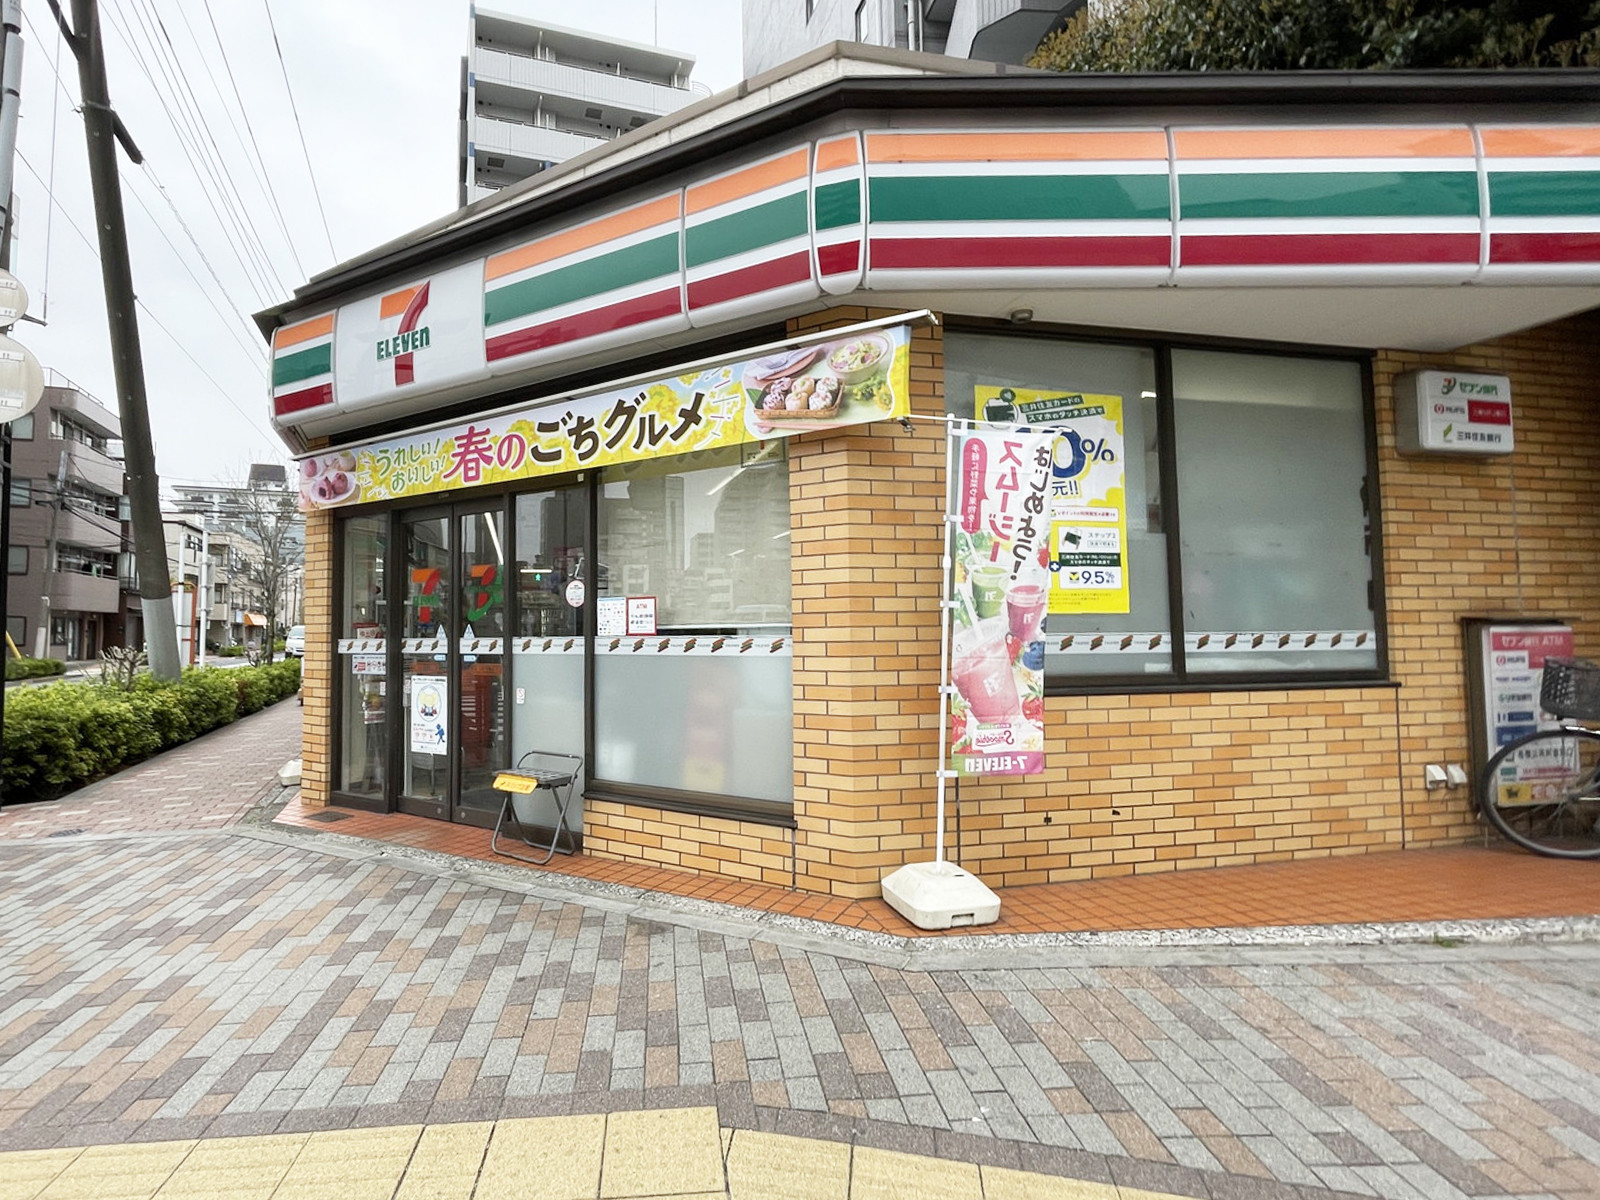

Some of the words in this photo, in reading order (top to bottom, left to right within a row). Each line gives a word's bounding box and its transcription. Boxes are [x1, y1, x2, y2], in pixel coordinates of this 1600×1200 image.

[443, 392, 704, 483] 春のごちグルメ
[1457, 431, 1502, 443] 三井住友銀行
[1542, 635, 1564, 646] ATM
